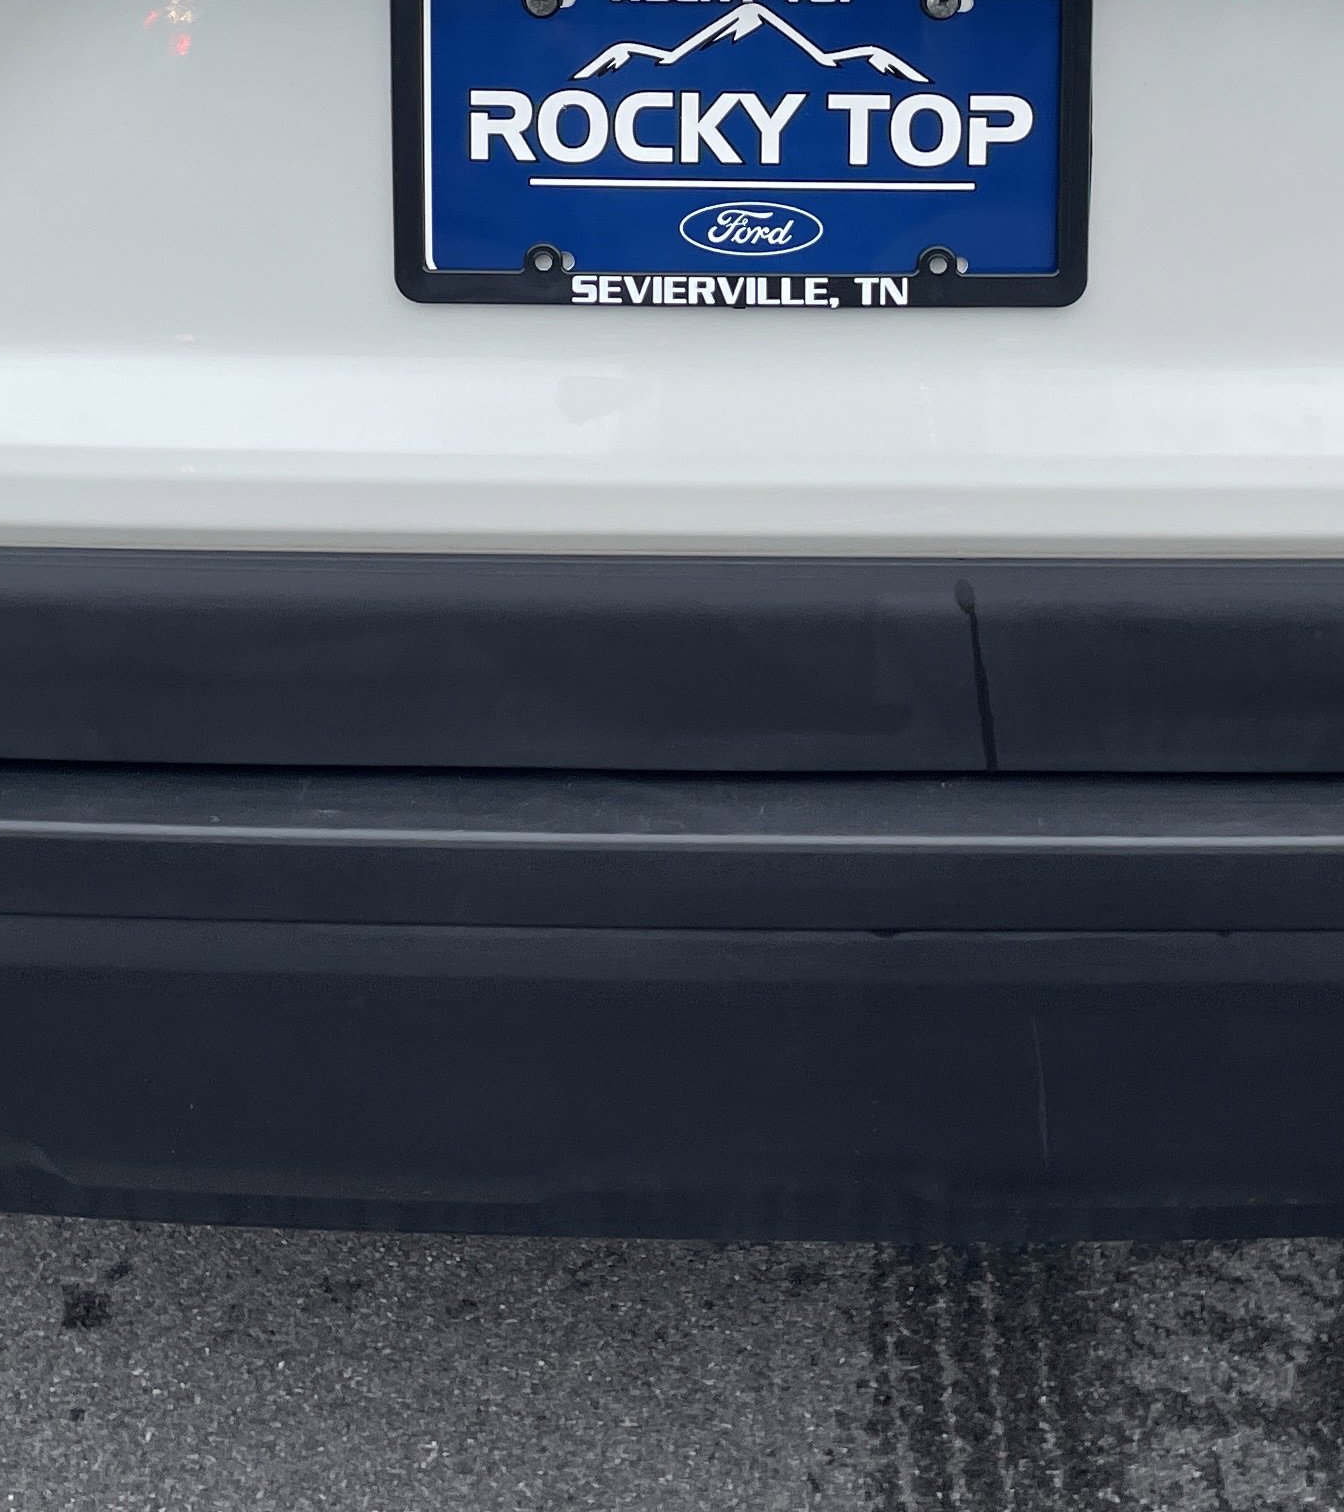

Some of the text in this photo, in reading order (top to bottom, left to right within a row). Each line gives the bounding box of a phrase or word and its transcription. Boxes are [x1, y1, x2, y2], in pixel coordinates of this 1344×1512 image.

[468, 90, 1034, 167] ROCKY TOP
[707, 209, 796, 246] Ford
[572, 277, 909, 309] SEVIERVILLE, TN
